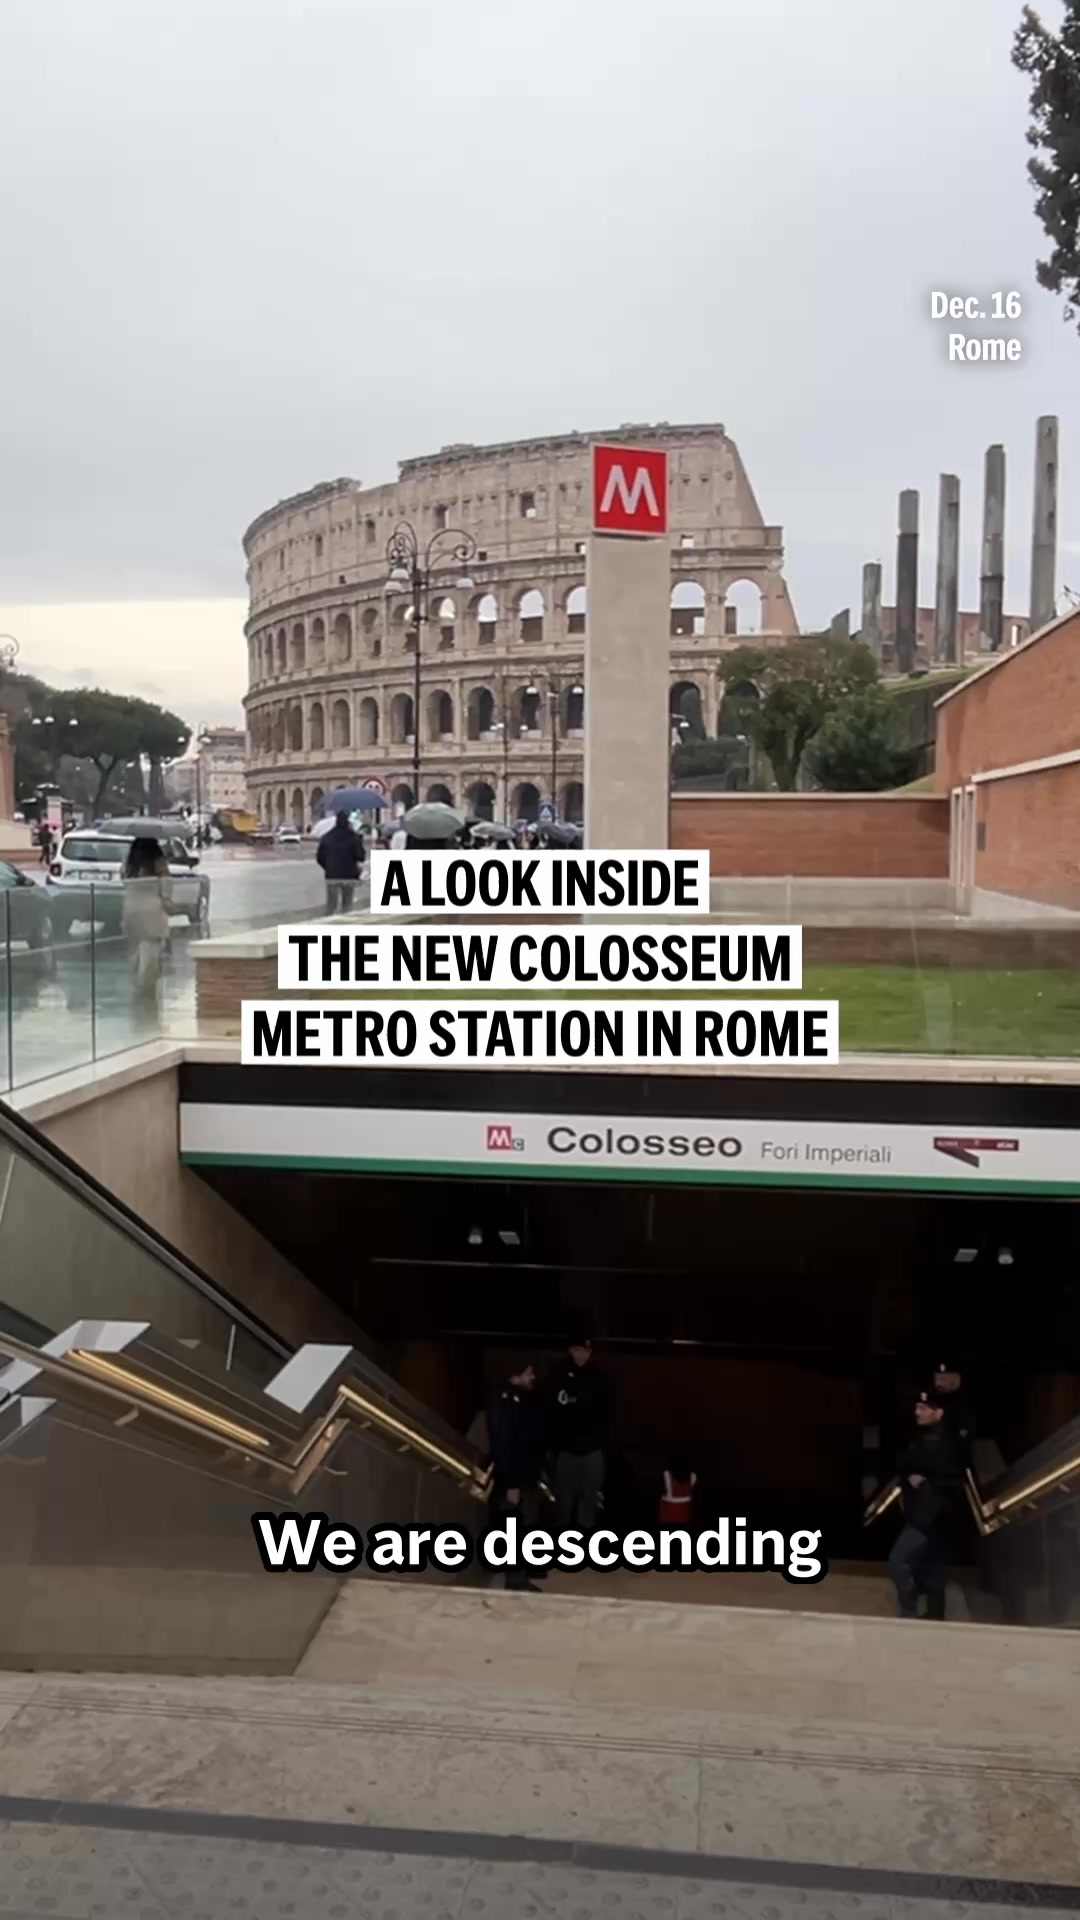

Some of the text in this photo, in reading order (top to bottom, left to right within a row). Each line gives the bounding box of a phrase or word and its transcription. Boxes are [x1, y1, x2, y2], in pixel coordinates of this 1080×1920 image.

[600, 464, 660, 517] M
[547, 1126, 743, 1159] Colosseo
[760, 1141, 892, 1167] Fori Imperiali
